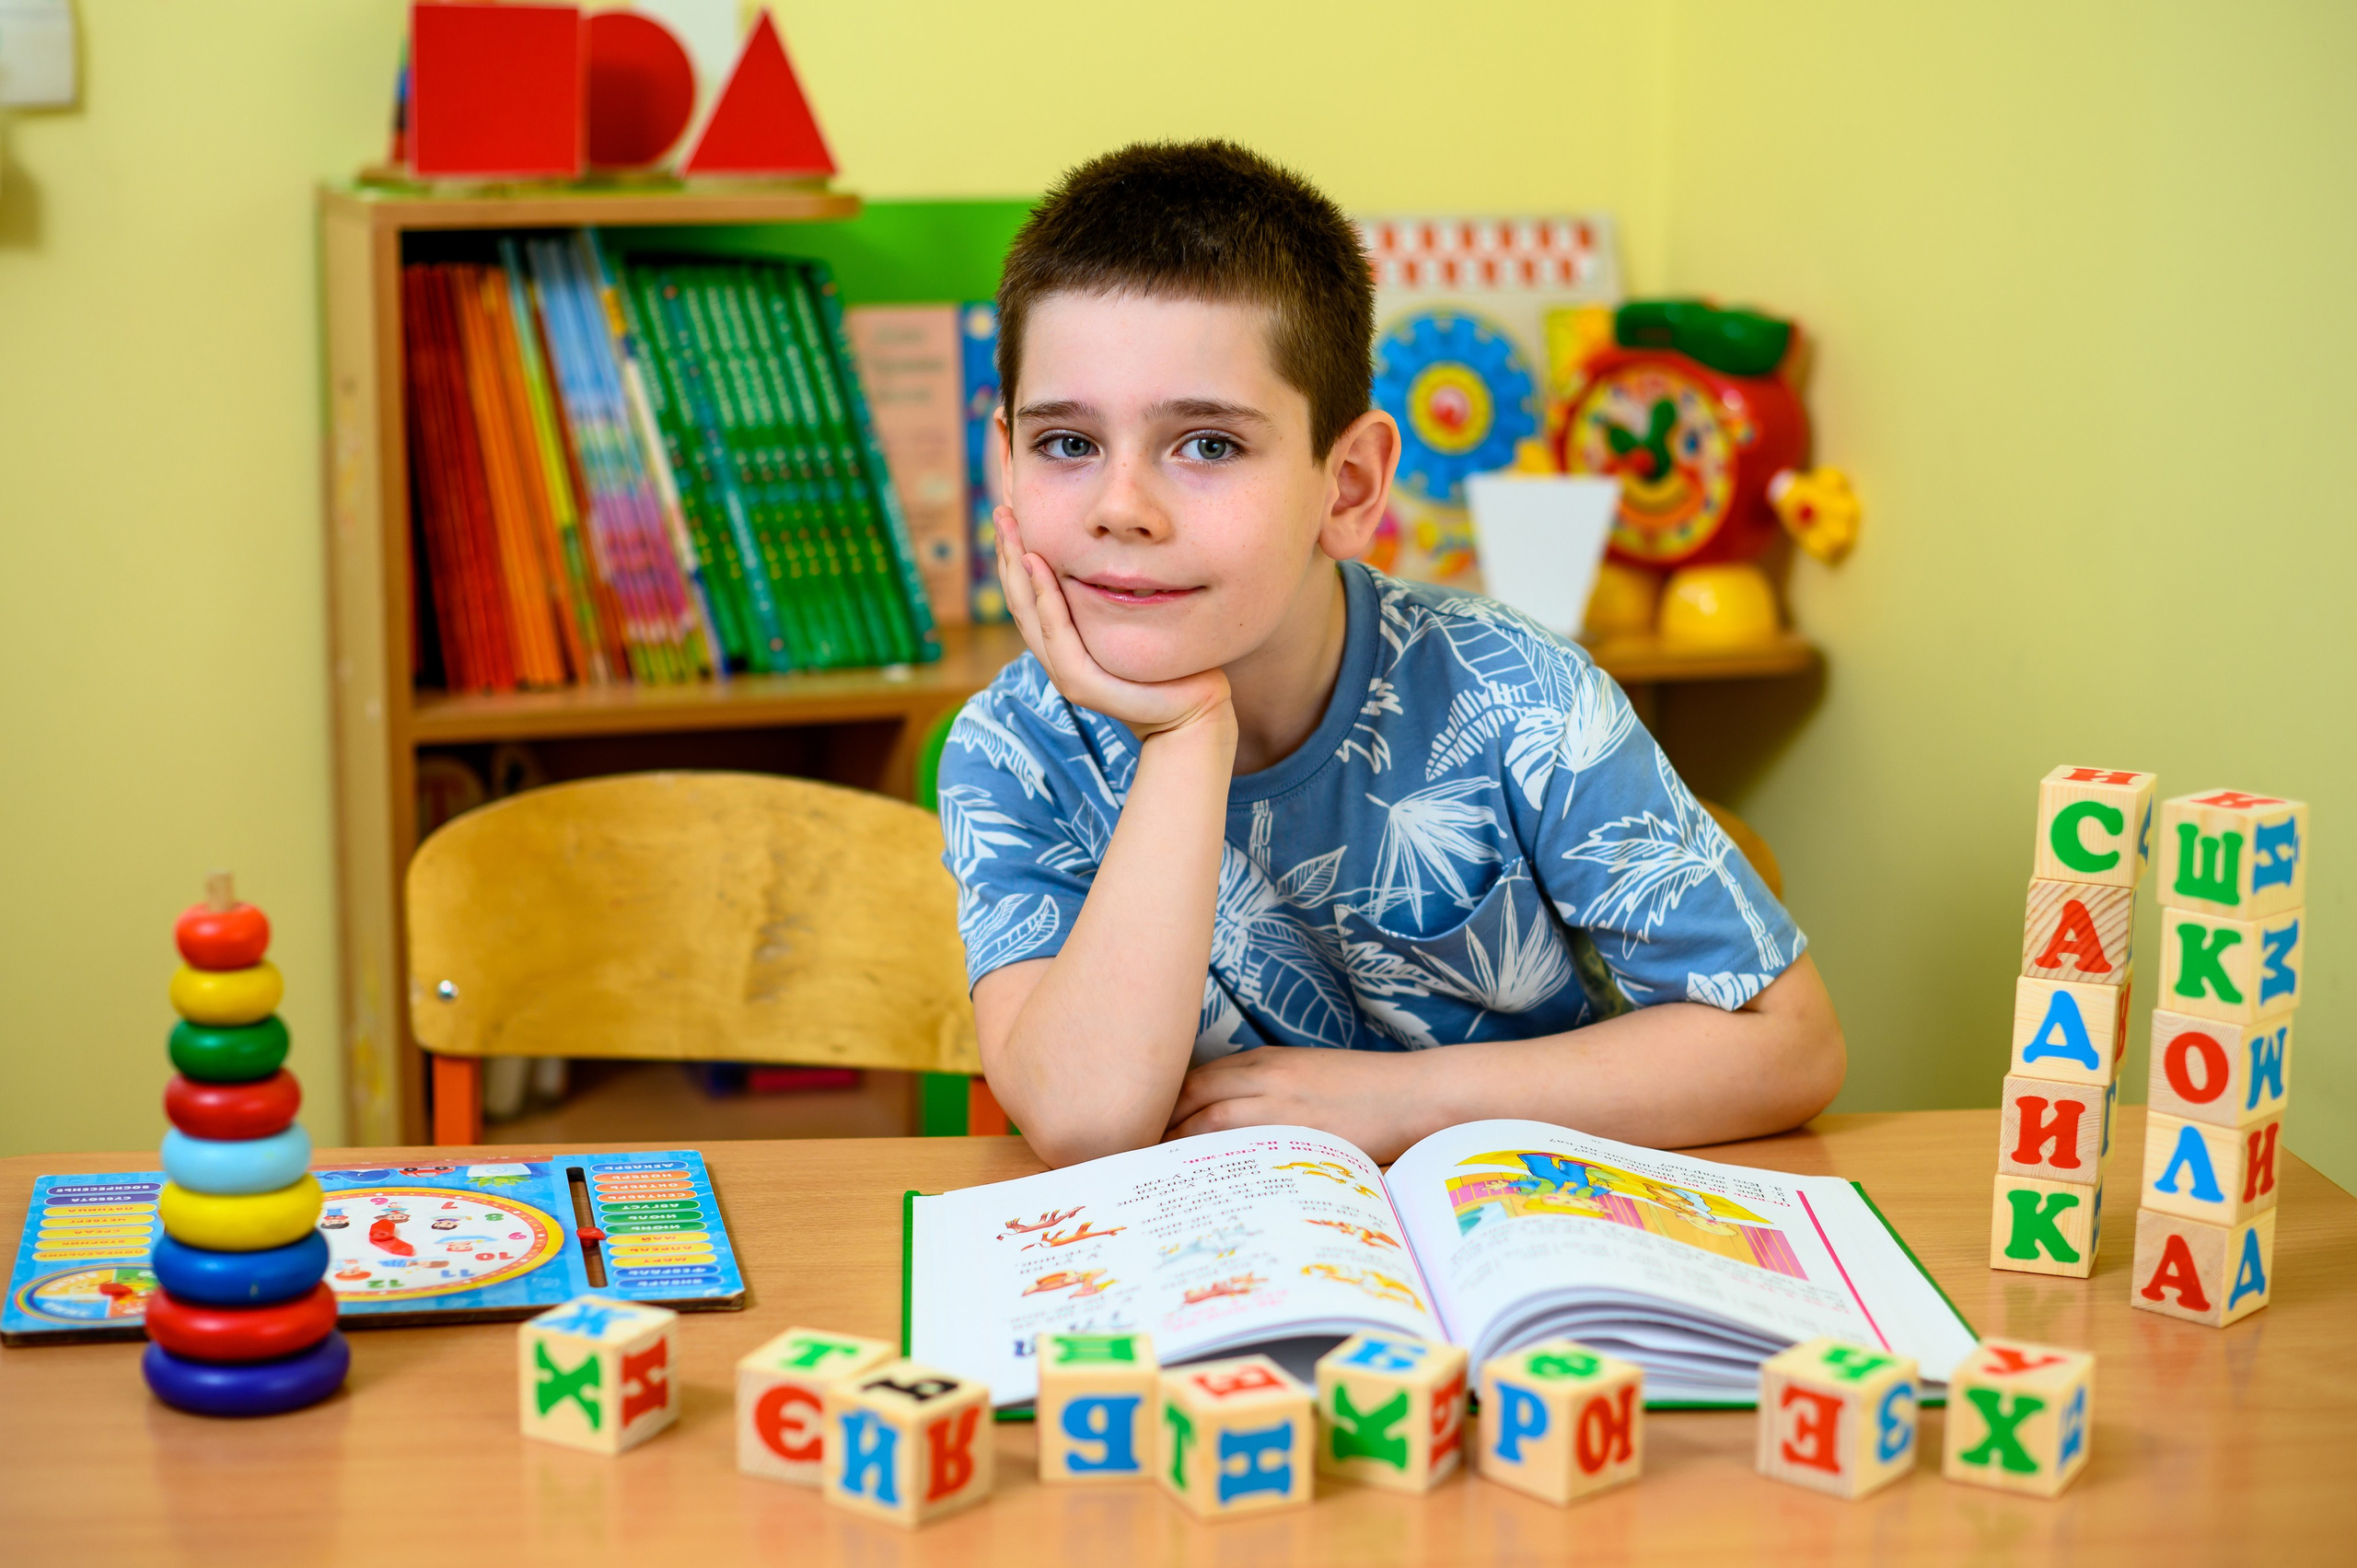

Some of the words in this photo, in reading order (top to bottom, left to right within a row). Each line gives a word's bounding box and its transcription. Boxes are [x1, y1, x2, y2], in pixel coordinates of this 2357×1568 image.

[604, 1163, 674, 1171] ДЕКАБРЬ
[55, 1185, 150, 1193] ВОСКРЕСЕНЬЕ
[370, 1197, 389, 1205] 6
[608, 1192, 686, 1201] СЕНТЯБРЬ
[441, 1202, 459, 1210] 7
[484, 1213, 505, 1222] 8
[508, 1232, 528, 1240] 9
[38, 1249, 144, 1259] ПОНЕДЕЛЬНИК
[475, 1251, 515, 1261] 10
[440, 1269, 475, 1279] 11
[628, 1267, 706, 1276] ФЕВРАЛЬ
[366, 1279, 405, 1289] 12
[637, 1278, 703, 1287] ЯНВАРЬ
[1494, 1381, 1550, 1464] Р
[1959, 1387, 2046, 1474] Х
